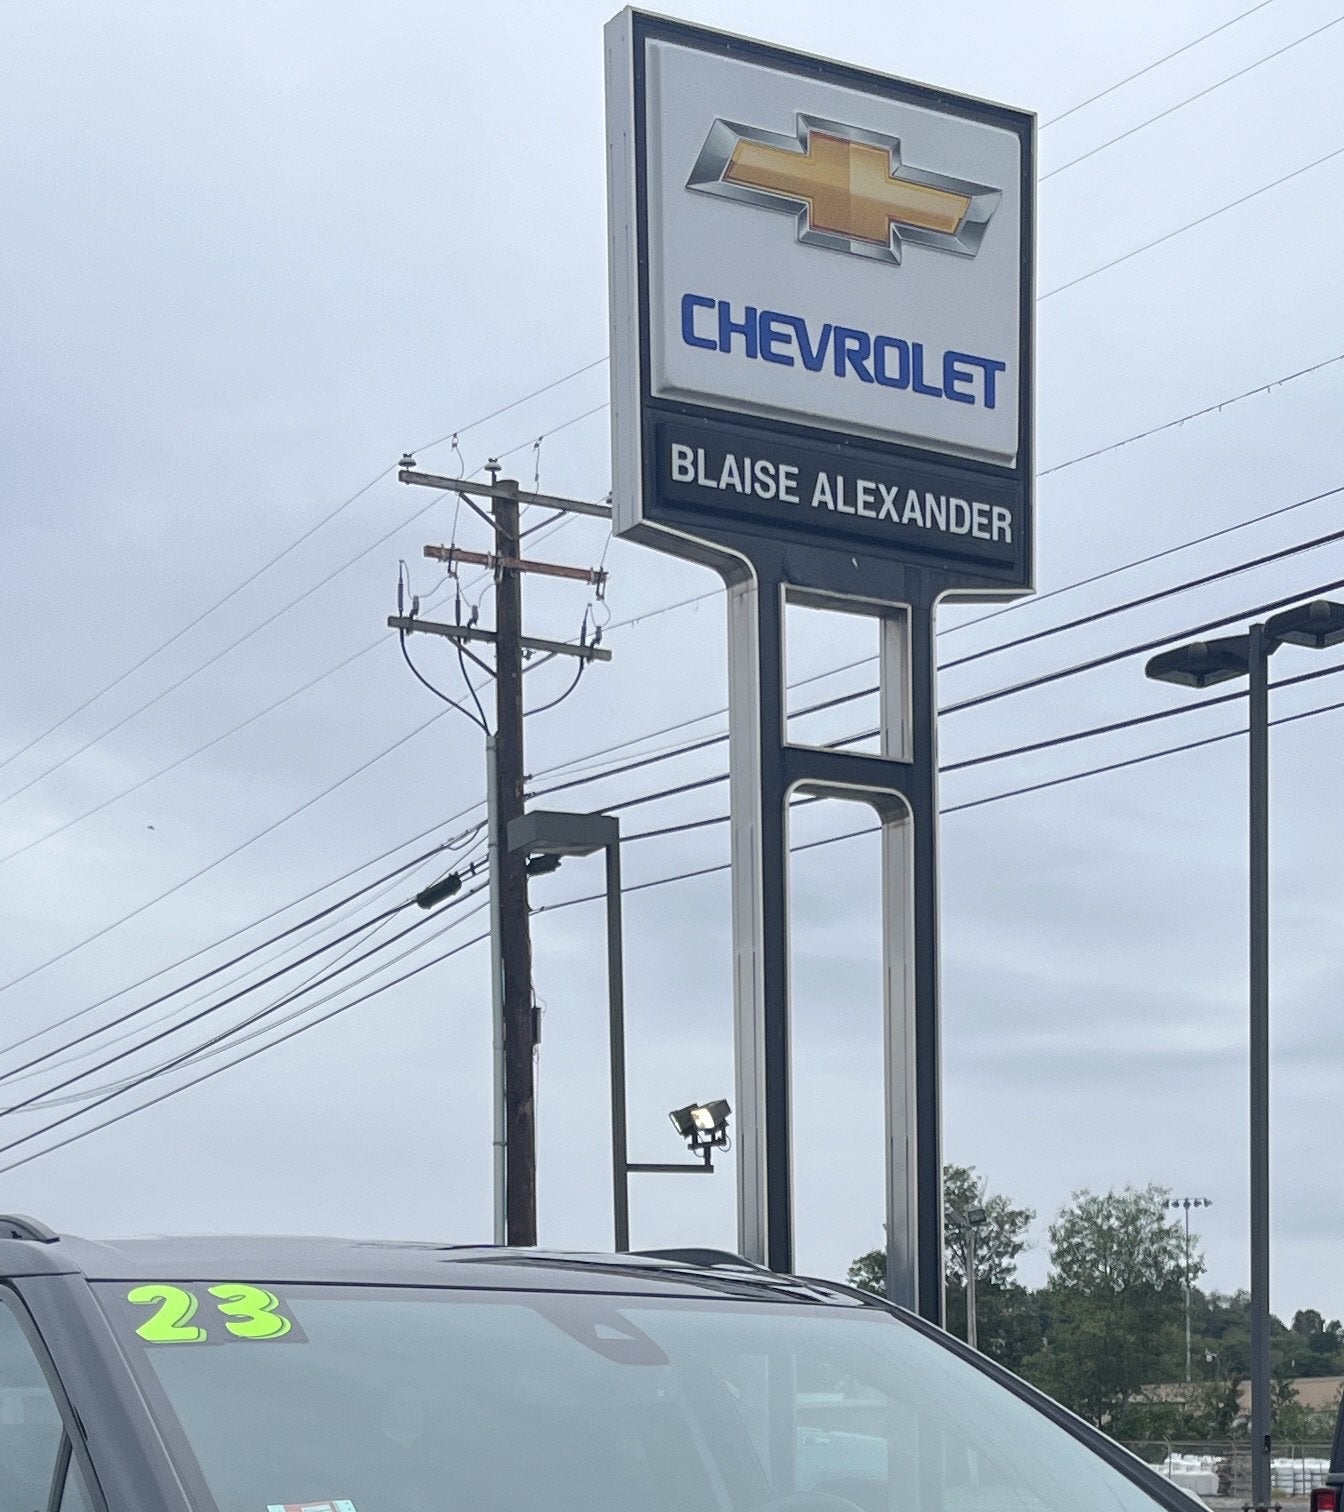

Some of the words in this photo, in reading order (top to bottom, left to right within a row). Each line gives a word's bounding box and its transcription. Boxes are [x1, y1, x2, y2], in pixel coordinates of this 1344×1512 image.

[681, 293, 1006, 409] CHEVROLET
[670, 443, 799, 504] BLAISE
[811, 472, 1013, 543] ALEXANDER
[127, 1284, 292, 1344] 23
